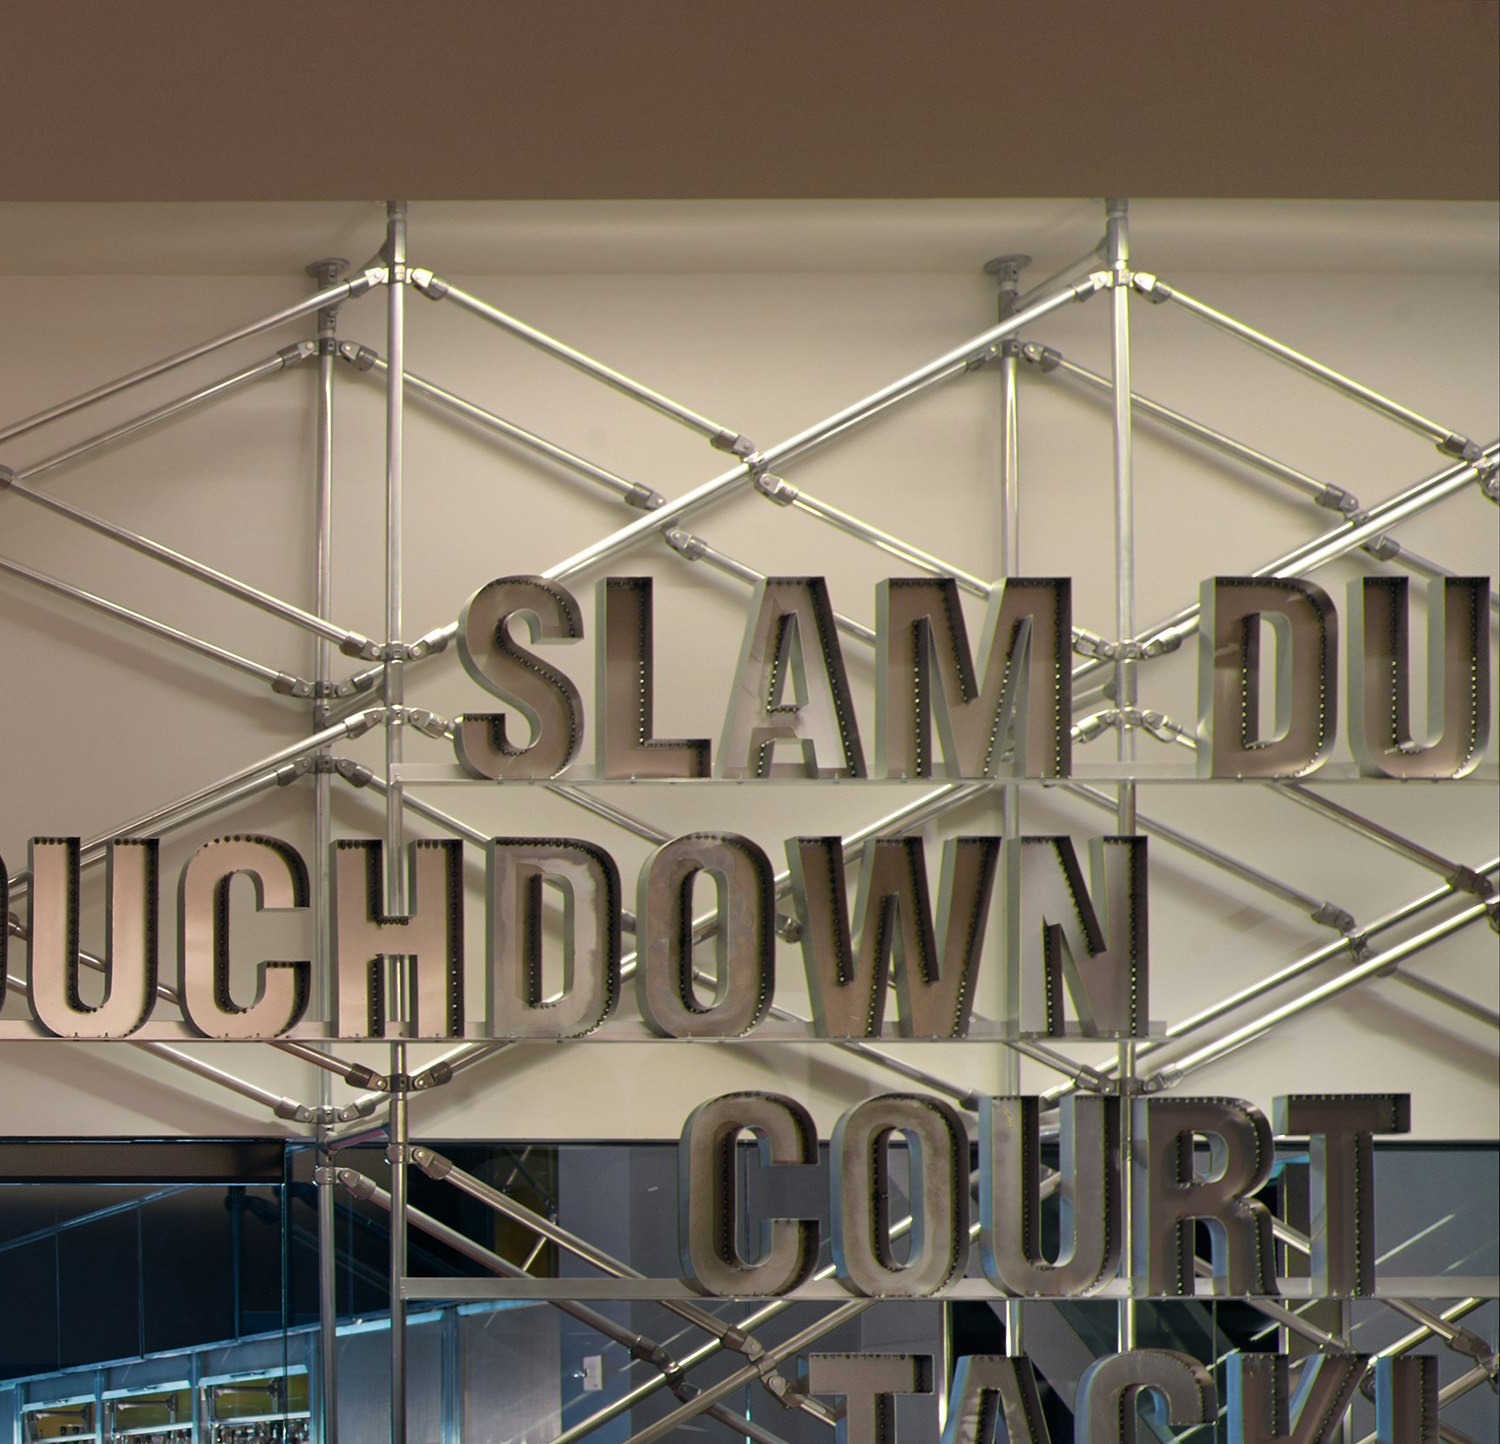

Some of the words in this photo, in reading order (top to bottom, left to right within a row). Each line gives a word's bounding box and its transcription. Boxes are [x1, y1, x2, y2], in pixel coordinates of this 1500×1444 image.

[453, 574, 1072, 780] SLAM
[1196, 575, 1491, 780] DU
[679, 1091, 1412, 1298] COURT
